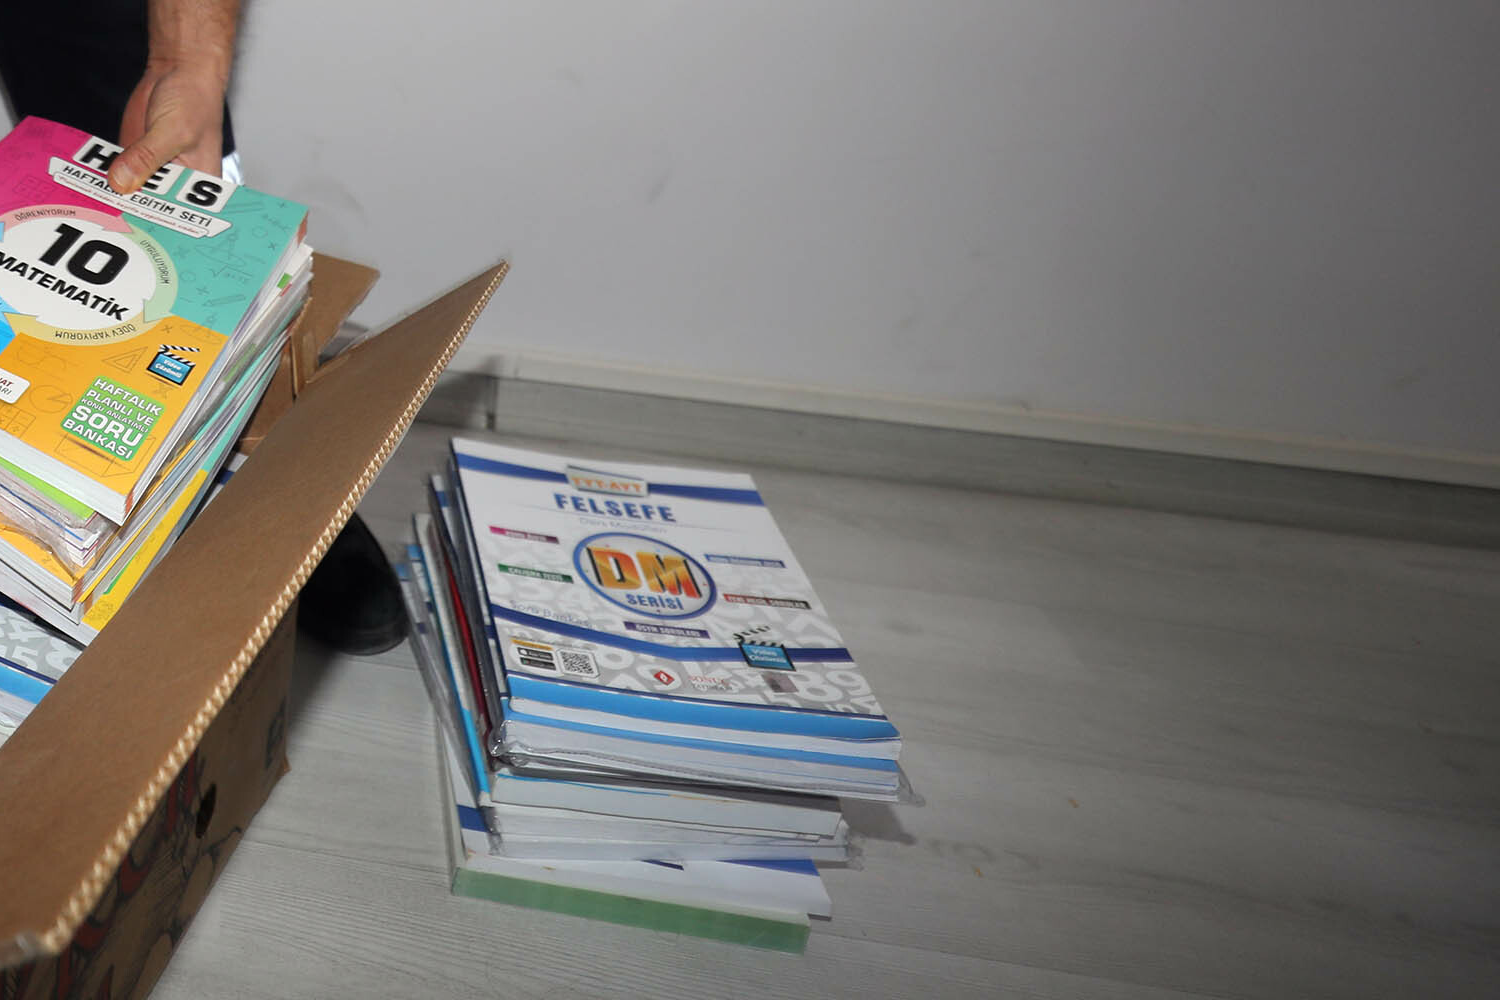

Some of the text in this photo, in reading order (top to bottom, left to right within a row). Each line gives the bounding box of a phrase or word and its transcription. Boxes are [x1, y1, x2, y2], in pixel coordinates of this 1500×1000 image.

[130, 192, 175, 215] EĞİTİM
[179, 210, 213, 228] SETİ
[38, 222, 130, 286] 10
[81, 397, 104, 412] KONU
[86, 389, 155, 427] PLANLI VE
[94, 378, 163, 416] HAFTALIK
[62, 418, 133, 460] BANKASI
[71, 404, 144, 447] SORU
[553, 492, 677, 523] FELSEFE
[586, 545, 703, 600] DM
[626, 593, 685, 611] SERİSİ
